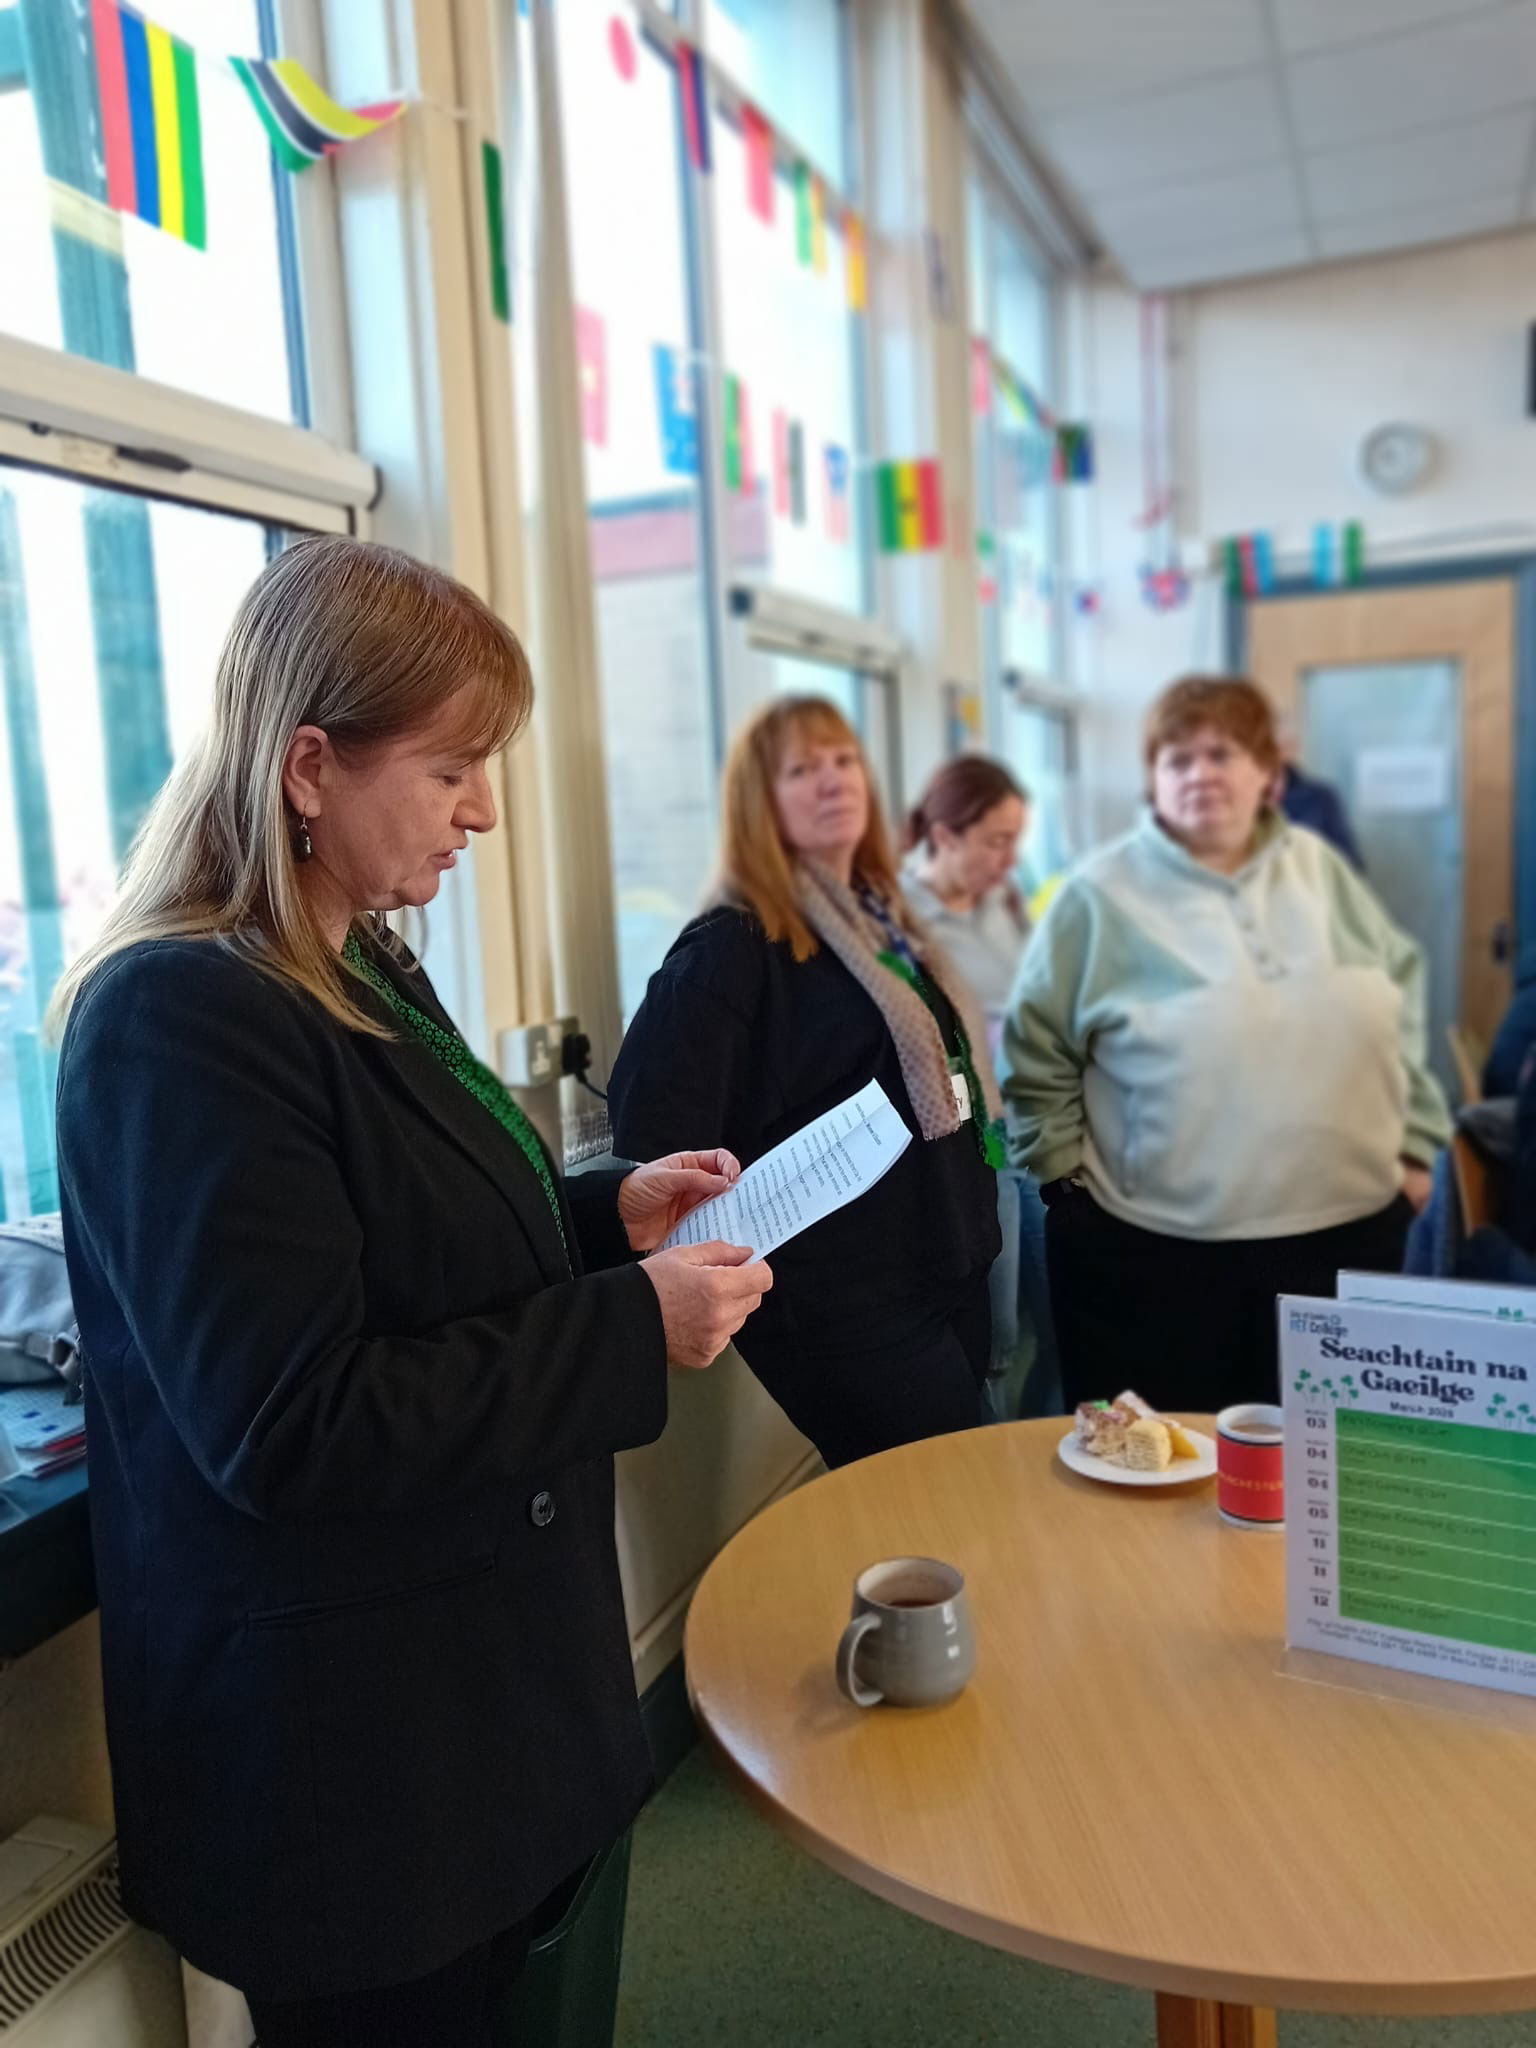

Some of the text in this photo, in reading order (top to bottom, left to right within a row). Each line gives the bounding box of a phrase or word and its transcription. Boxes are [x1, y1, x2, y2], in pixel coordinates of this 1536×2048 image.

[1320, 1337, 1528, 1382] Seachtain na
[1361, 1369, 1475, 1406] Gaeilge
[1390, 1401, 1424, 1413] March
[1306, 1417, 1327, 1429] 03
[1307, 1447, 1327, 1459] 04
[1308, 1507, 1329, 1519] 05
[1314, 1595, 1329, 1607] 12
